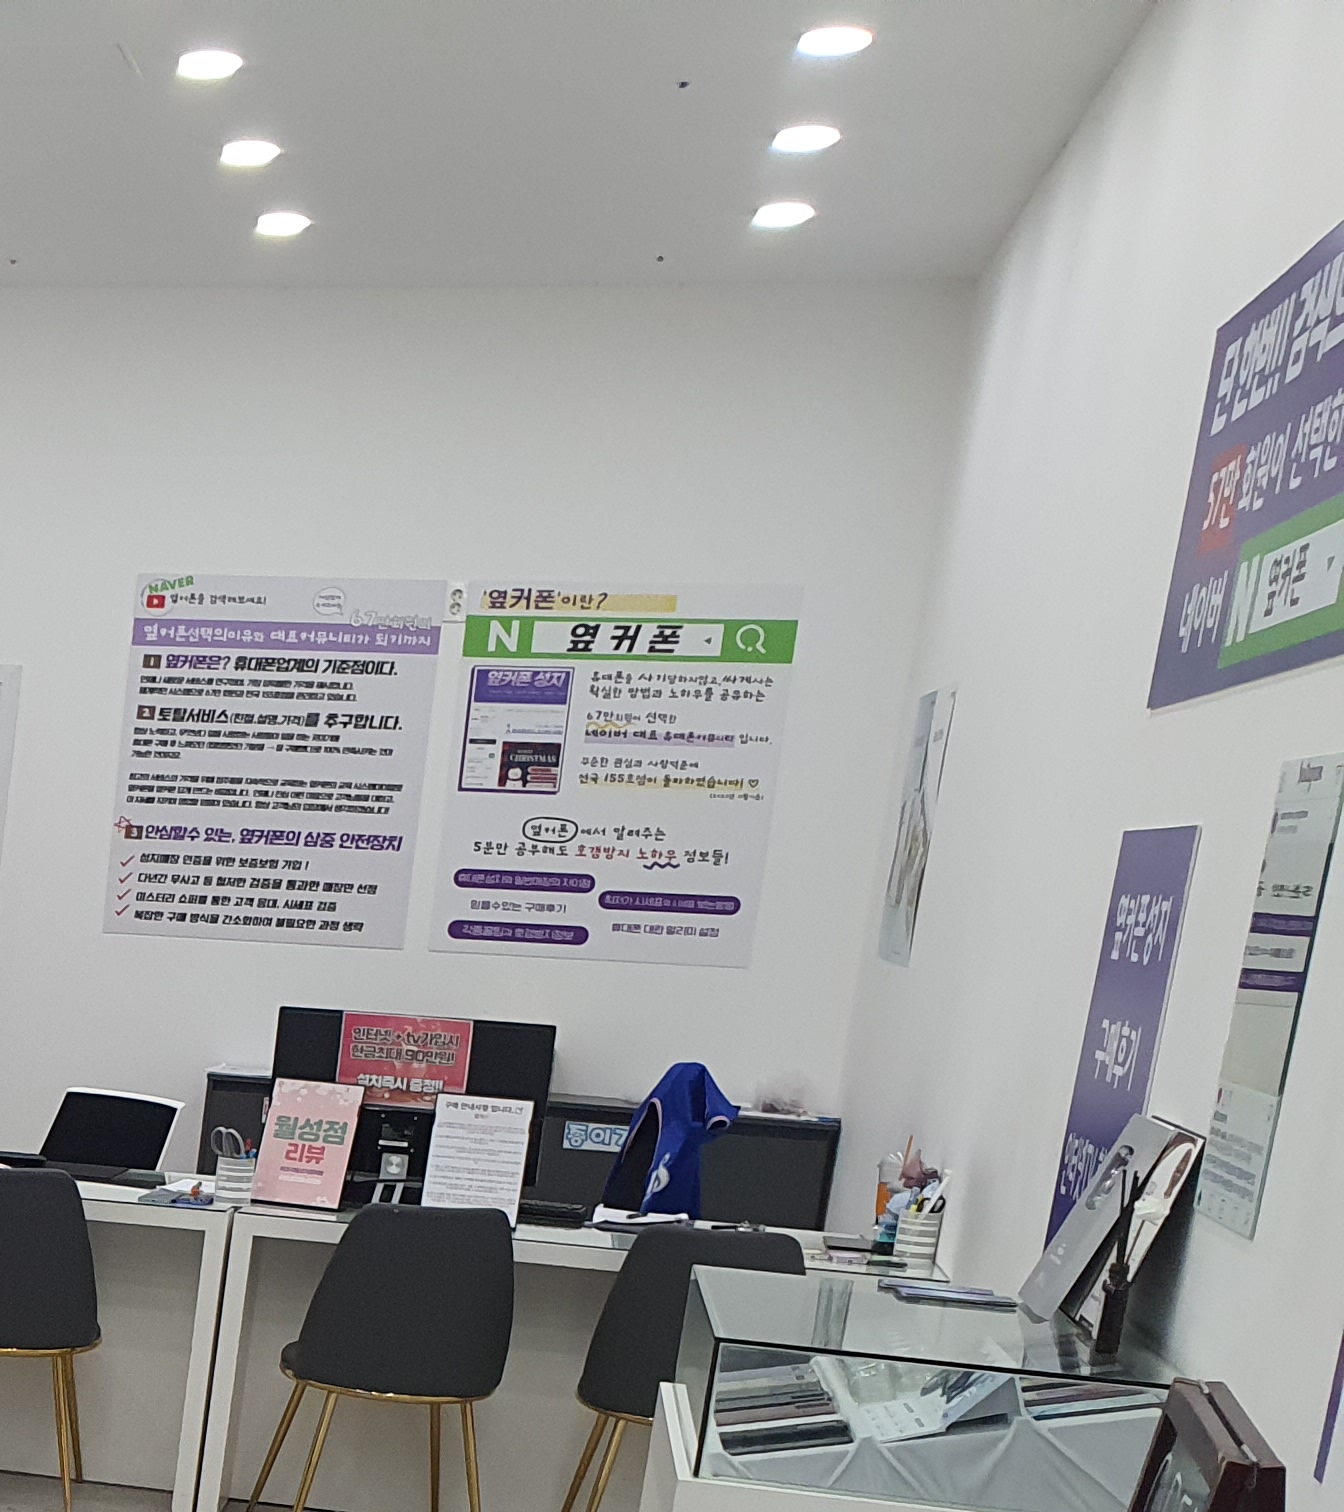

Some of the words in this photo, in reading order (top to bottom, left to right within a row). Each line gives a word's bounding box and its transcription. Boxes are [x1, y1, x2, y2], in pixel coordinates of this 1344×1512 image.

[148, 575, 194, 594] NAVER
[1225, 554, 1260, 647] N
[488, 620, 519, 652] N
[166, 654, 231, 670] 옆커폰은?
[234, 656, 320, 674] 휴대폰업계의
[322, 660, 397, 675] 기준점이다.
[534, 672, 565, 687] 성지
[324, 713, 402, 730] 추구합니다.
[585, 729, 627, 738] 네이버
[633, 731, 658, 740] 대표
[510, 754, 556, 762] CHRISTMAS
[239, 828, 301, 847] 옆커폰의
[339, 833, 403, 851] 안전장치
[515, 842, 569, 856] 공부해도
[575, 845, 630, 859] 호갱방지
[636, 848, 677, 861] 노하우
[274, 1115, 348, 1145] 월성점
[285, 1143, 325, 1164] 리뷰
